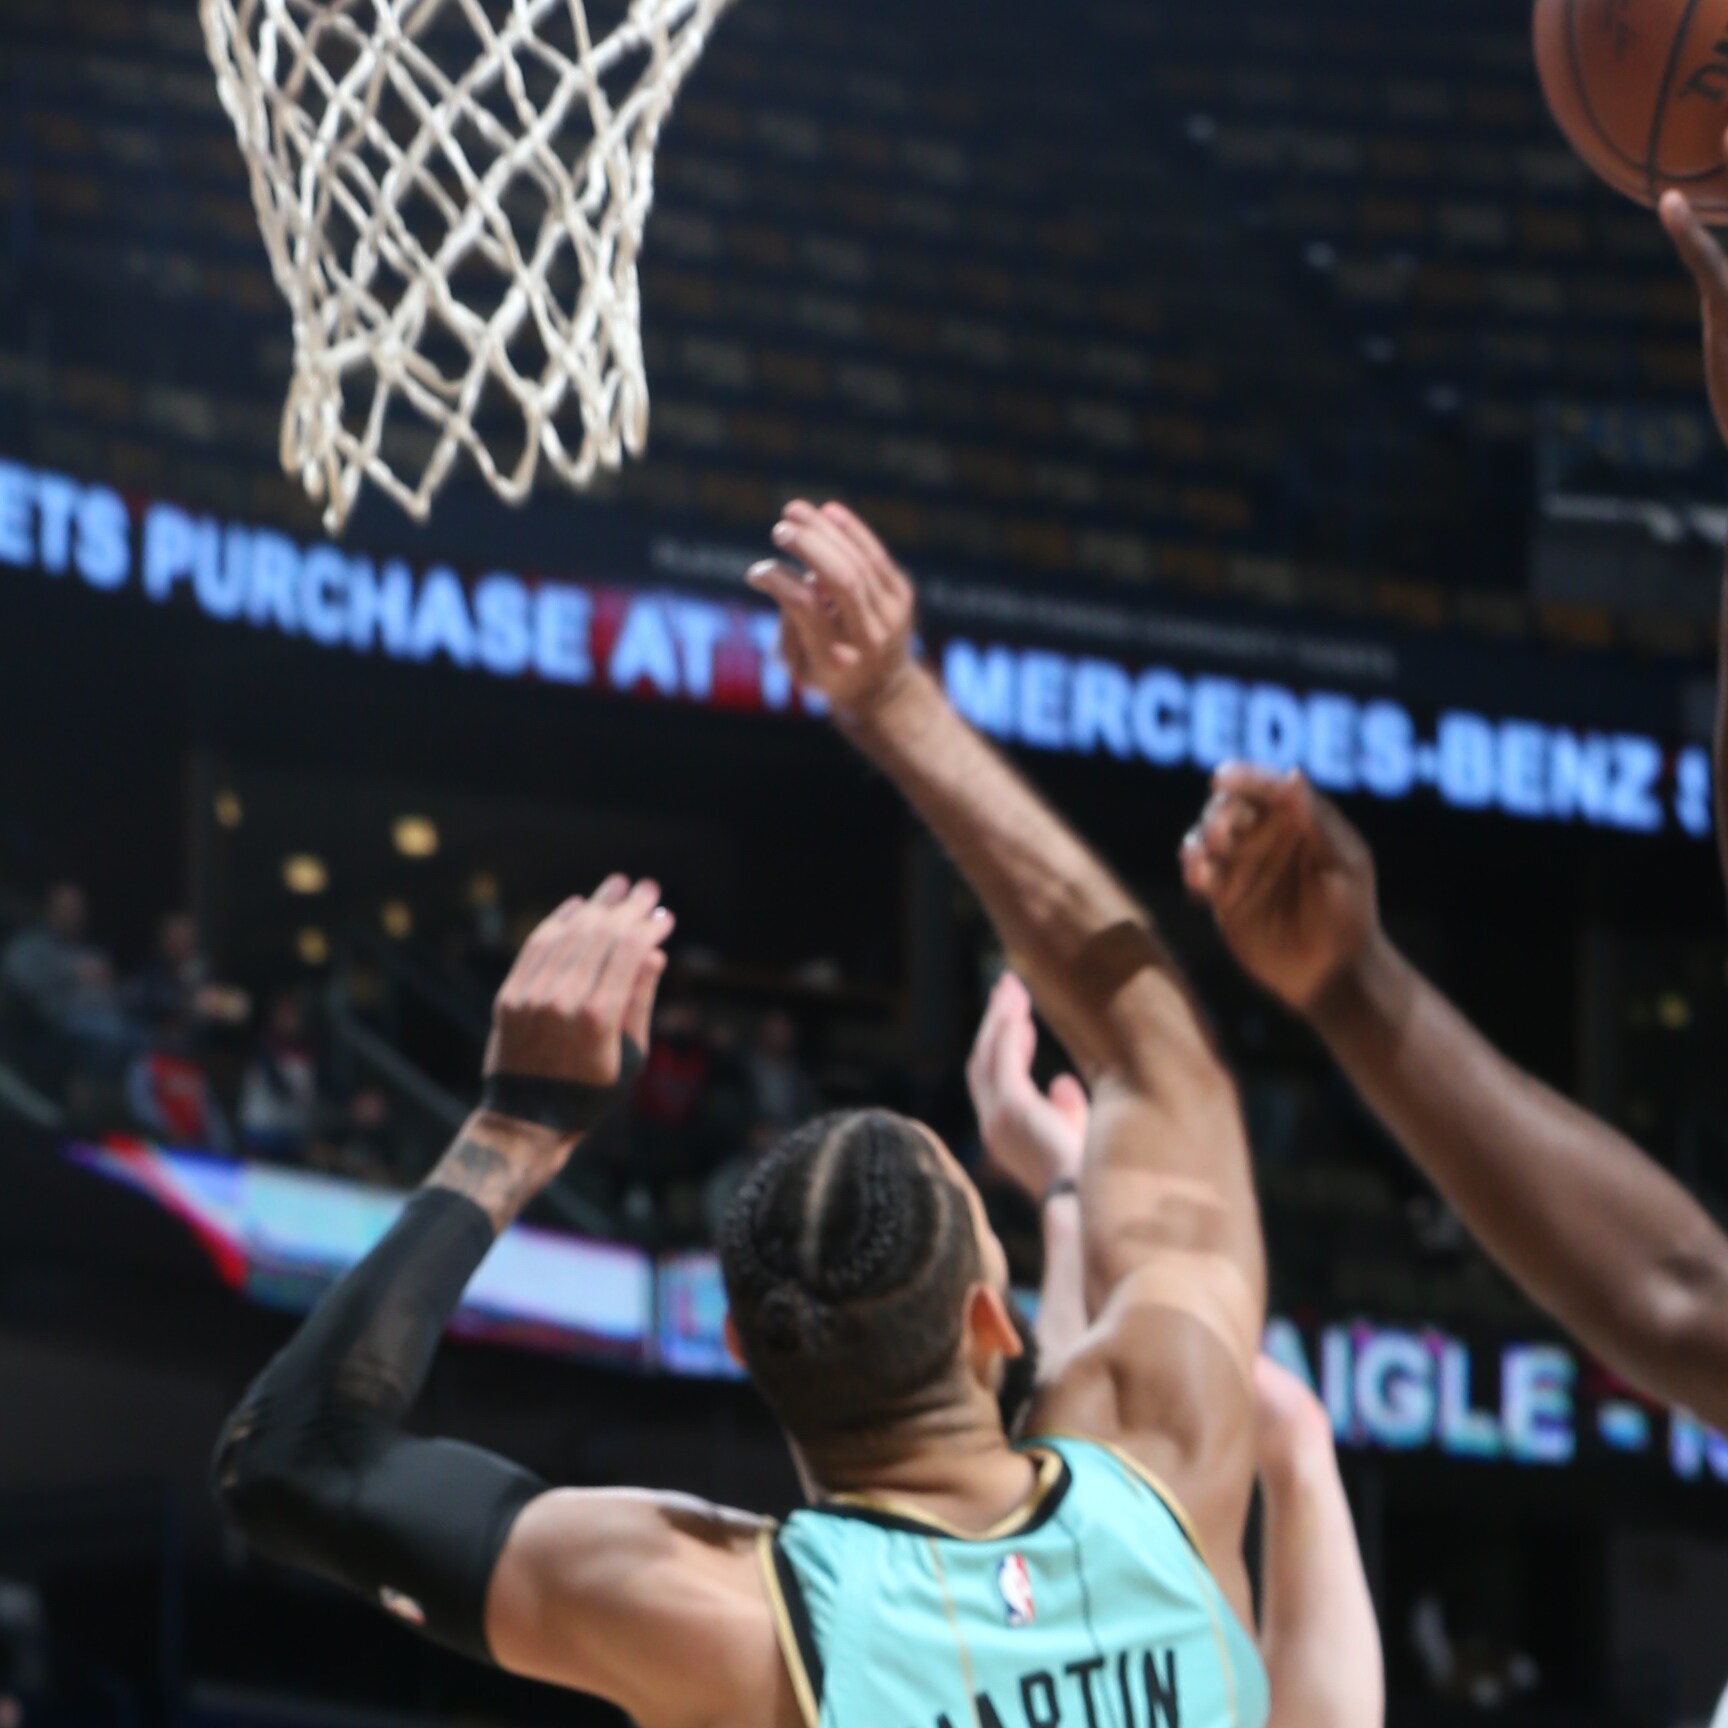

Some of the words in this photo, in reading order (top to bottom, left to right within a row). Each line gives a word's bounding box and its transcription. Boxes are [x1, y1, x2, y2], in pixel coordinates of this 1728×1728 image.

[142, 498, 595, 685] PURCHASE
[607, 593, 731, 701] AT
[943, 638, 1665, 834] MERCEDES-BENZ
